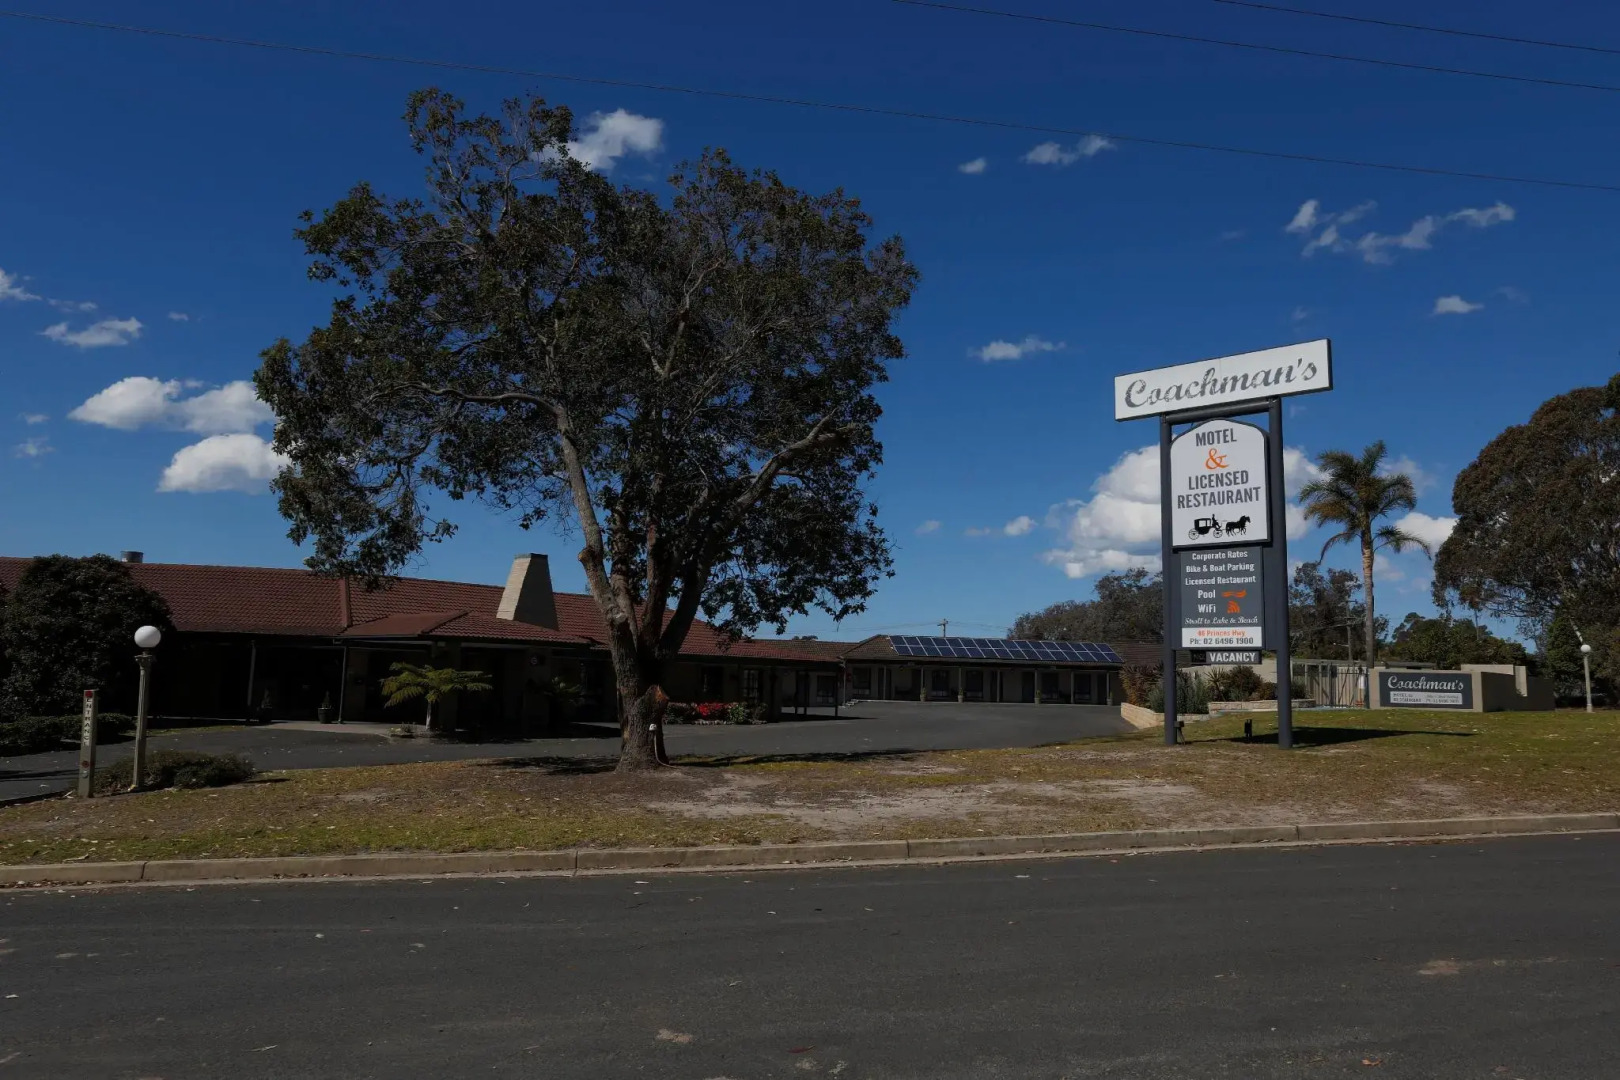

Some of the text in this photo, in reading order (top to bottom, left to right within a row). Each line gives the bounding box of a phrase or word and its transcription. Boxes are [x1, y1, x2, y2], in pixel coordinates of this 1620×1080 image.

[1124, 358, 1317, 408] Coachman's
[1195, 428, 1237, 447] MOTEL
[1205, 448, 1229, 470] &
[1188, 470, 1249, 490] LICENSED
[1177, 487, 1261, 509] RESTAURANT
[1192, 551, 1226, 561] Corporate
[1202, 564, 1208, 572] &
[1209, 563, 1226, 572] Boat
[1227, 562, 1255, 572] Parking
[1185, 576, 1257, 585] Licensed Restaurant
[1198, 590, 1216, 598] Pool
[1198, 604, 1216, 613] WiFi
[1238, 616, 1258, 624] Beach
[1232, 629, 1246, 637] Hwy
[1209, 652, 1256, 662] VACANCY
[1387, 675, 1464, 690] Coachman's
